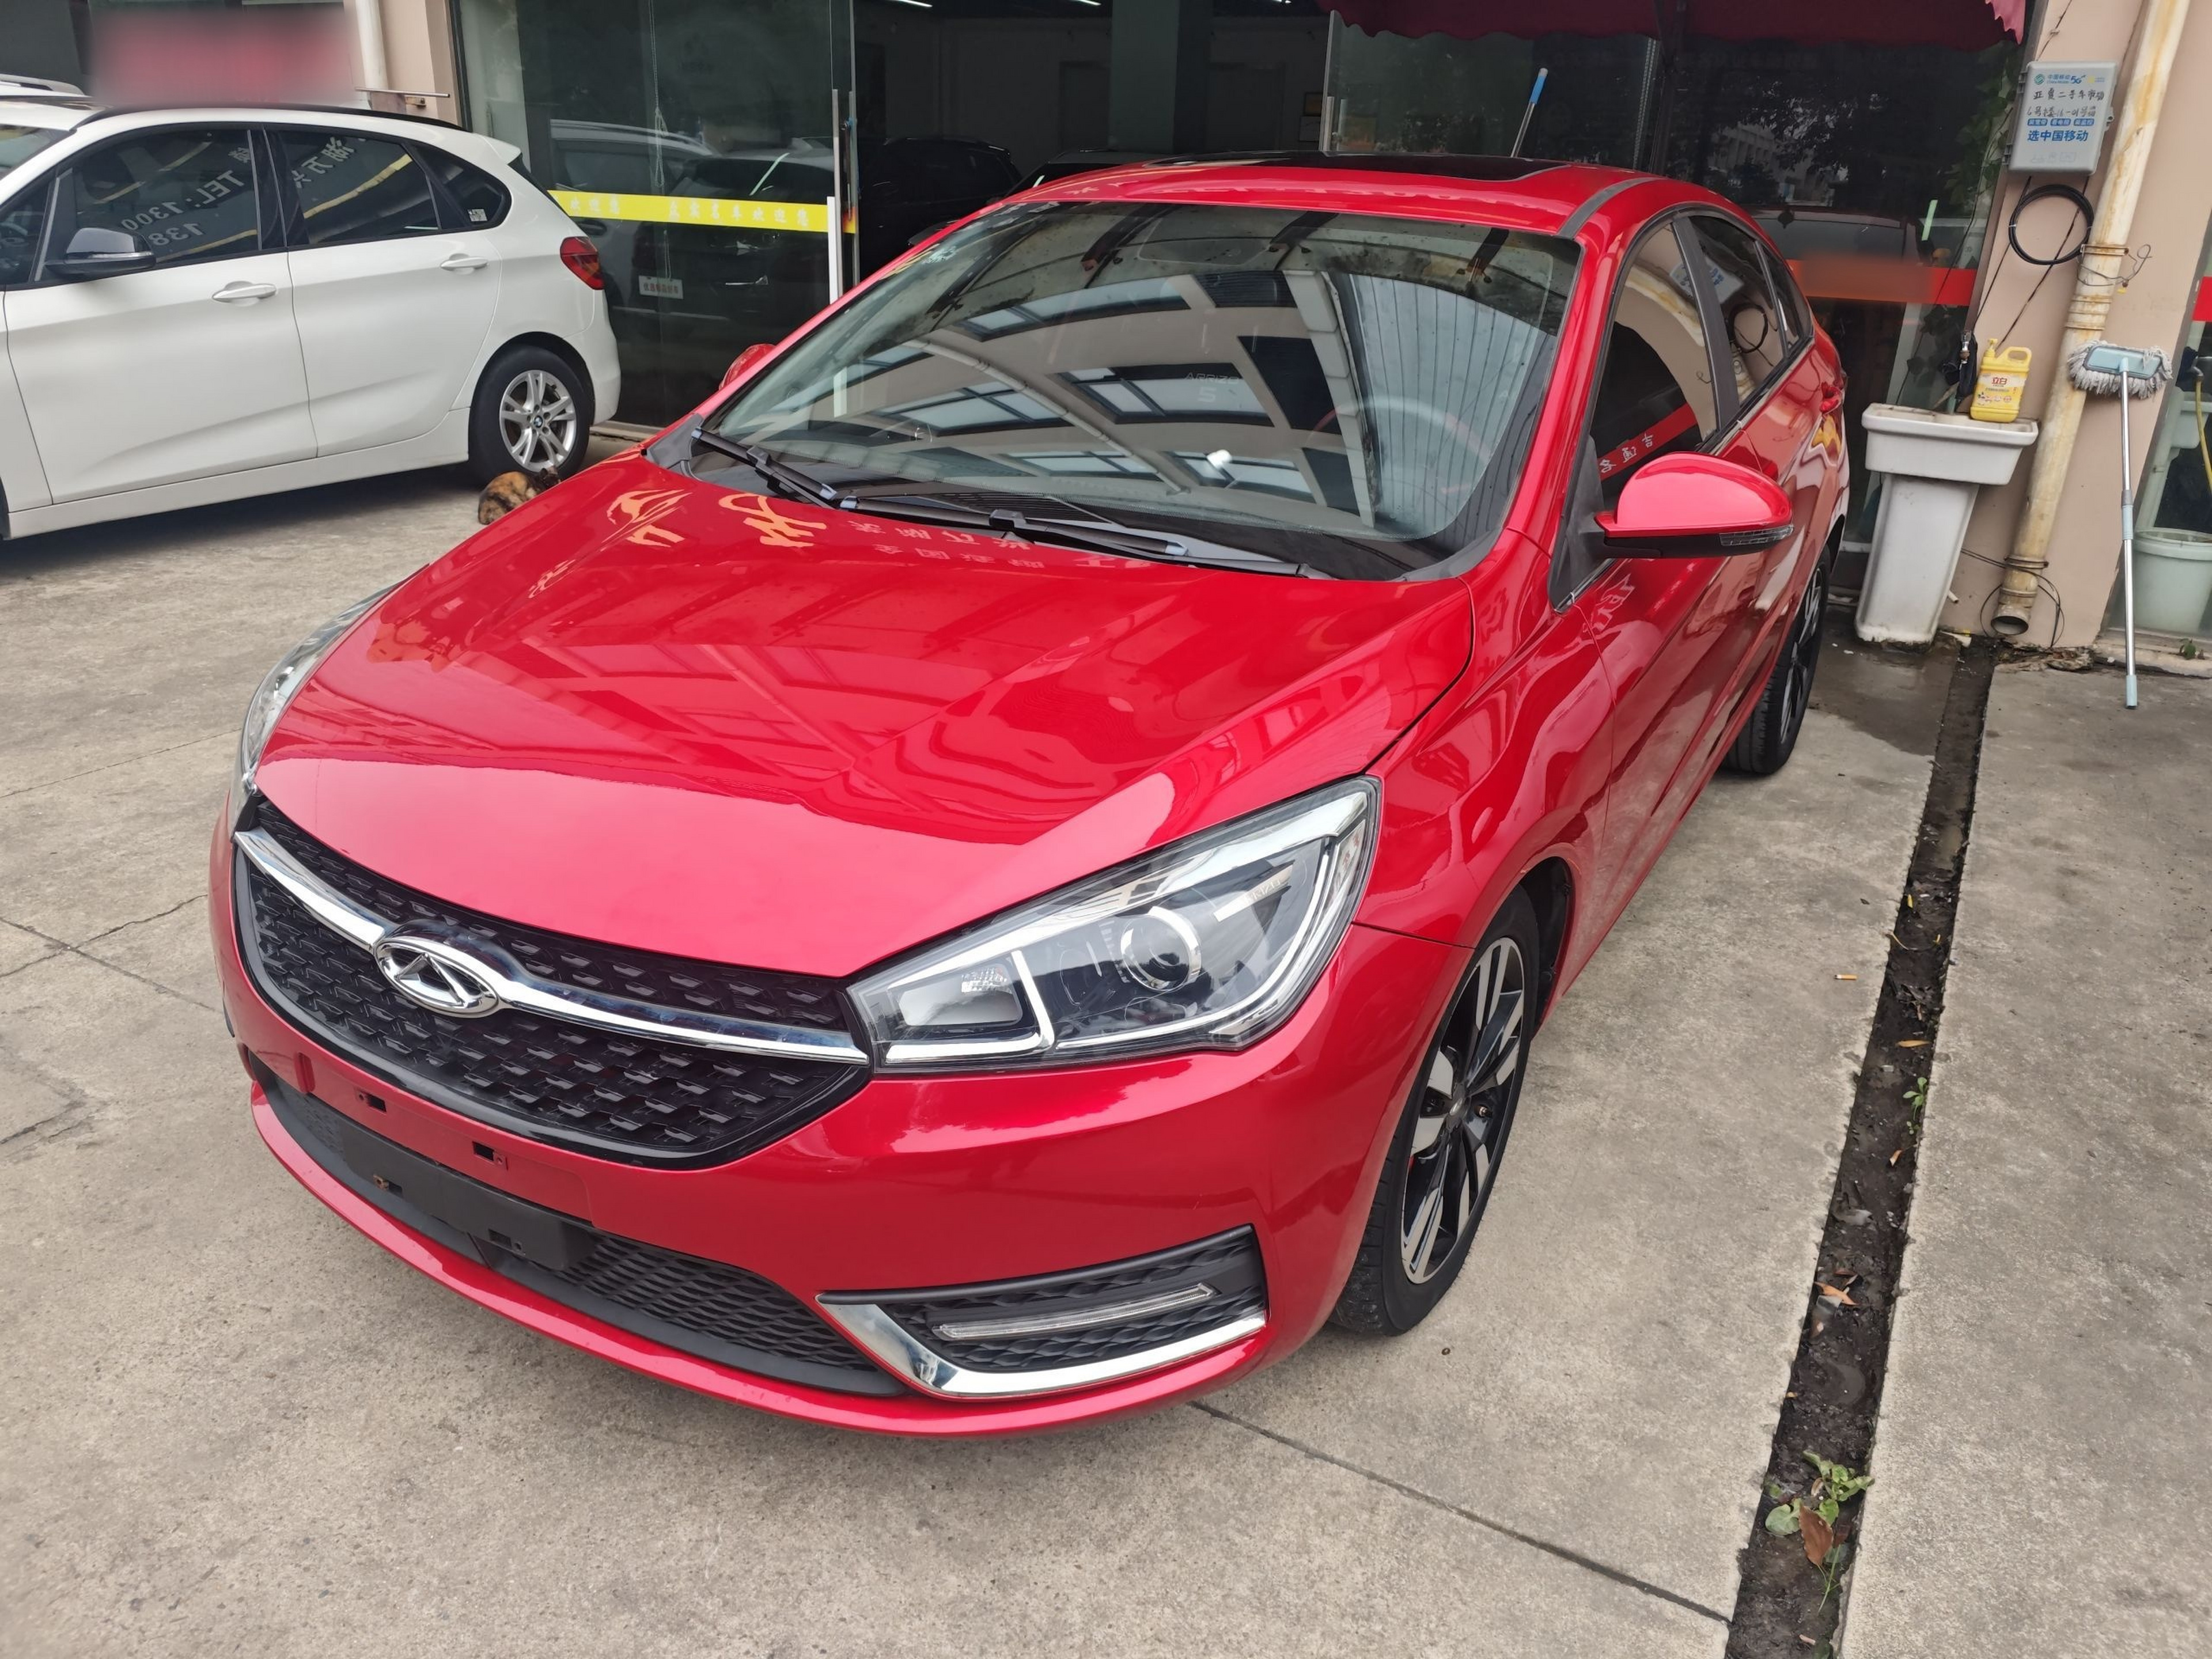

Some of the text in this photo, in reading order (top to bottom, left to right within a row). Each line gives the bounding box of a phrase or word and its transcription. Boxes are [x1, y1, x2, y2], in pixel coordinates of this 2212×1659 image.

[2027, 130, 2089, 142] 选中国移动
[1991, 377, 2008, 385] 立白
[1198, 387, 1217, 403] 5
